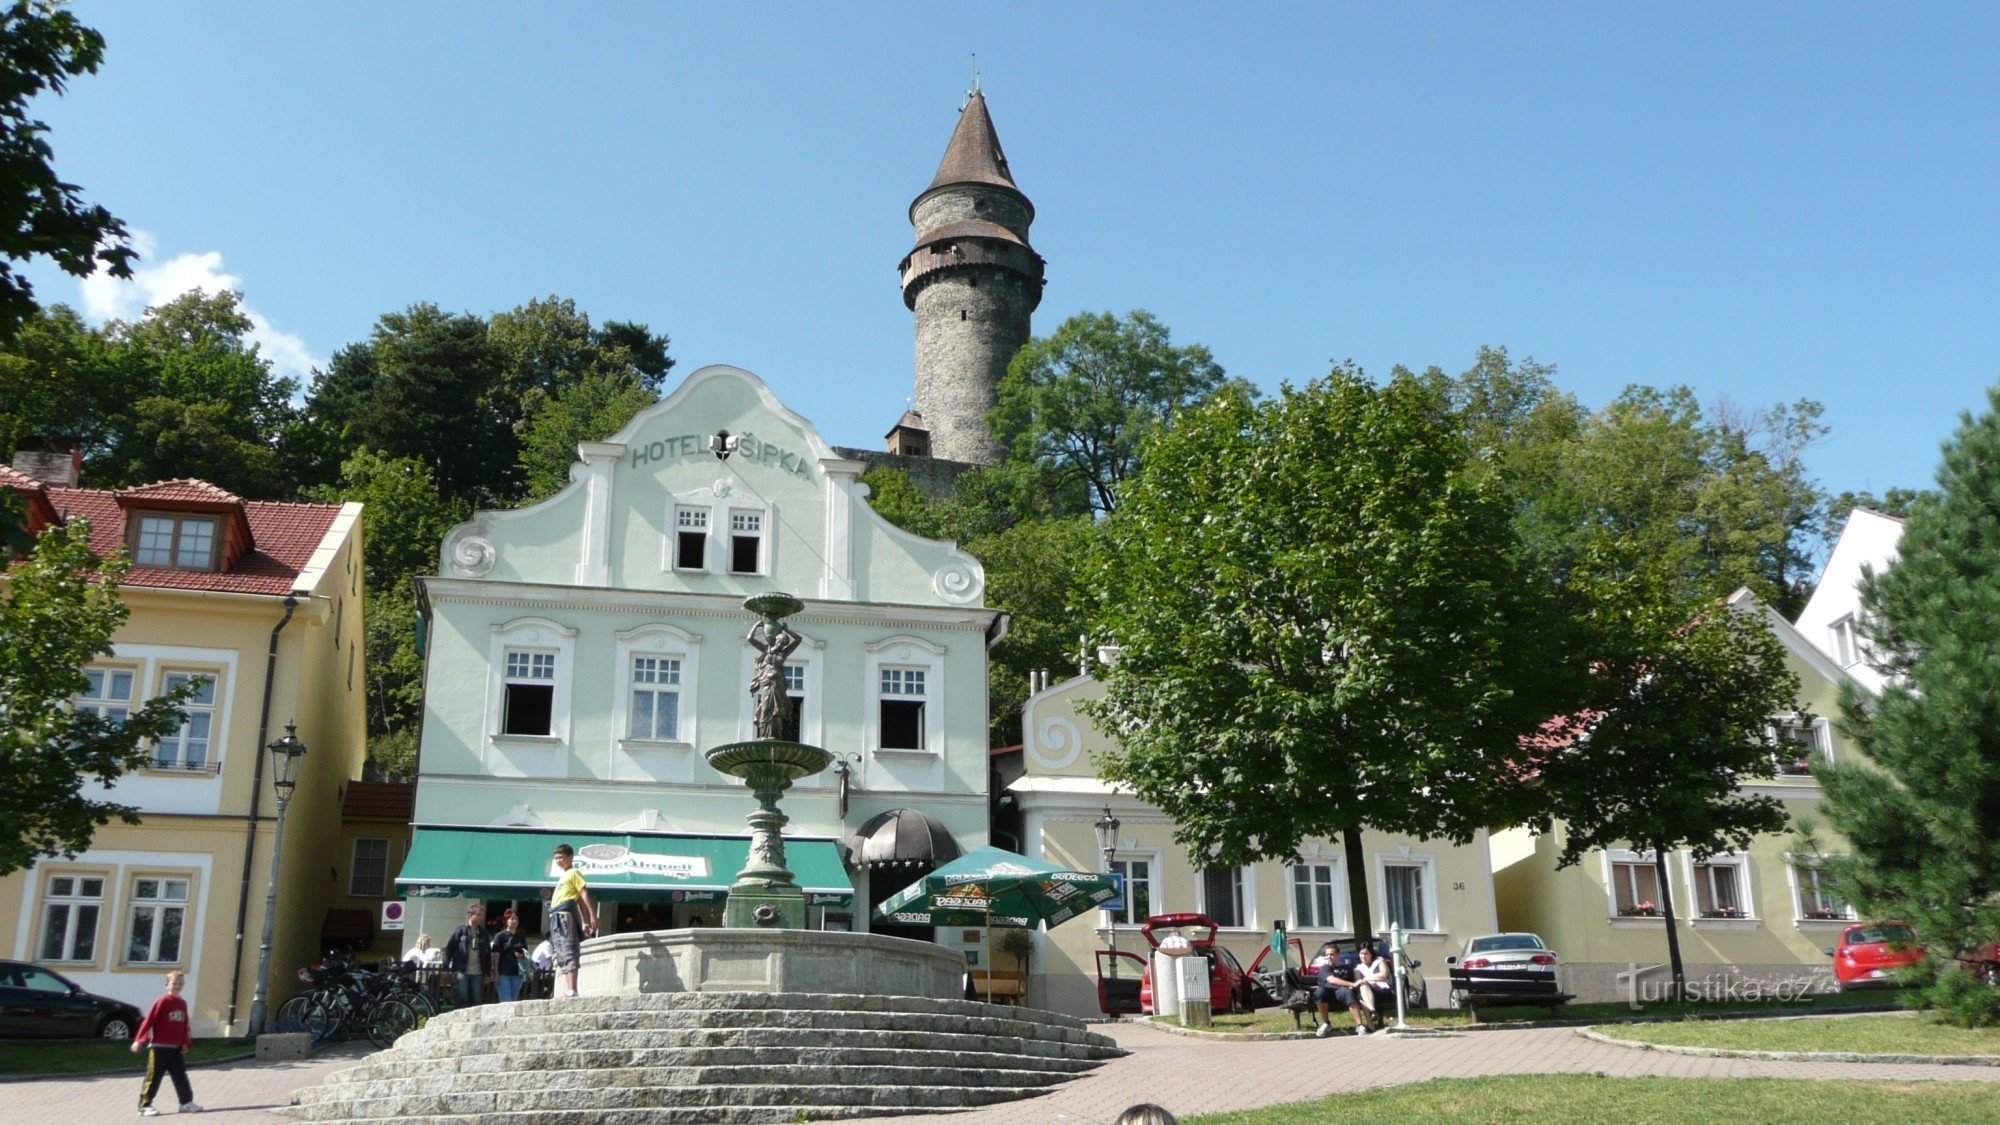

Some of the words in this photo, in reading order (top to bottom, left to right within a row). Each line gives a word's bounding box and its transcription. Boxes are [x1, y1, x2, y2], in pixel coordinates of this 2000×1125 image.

[632, 434, 709, 469] HOTEL
[739, 432, 811, 481] ŠIPKA
[1452, 882, 1466, 891] 36
